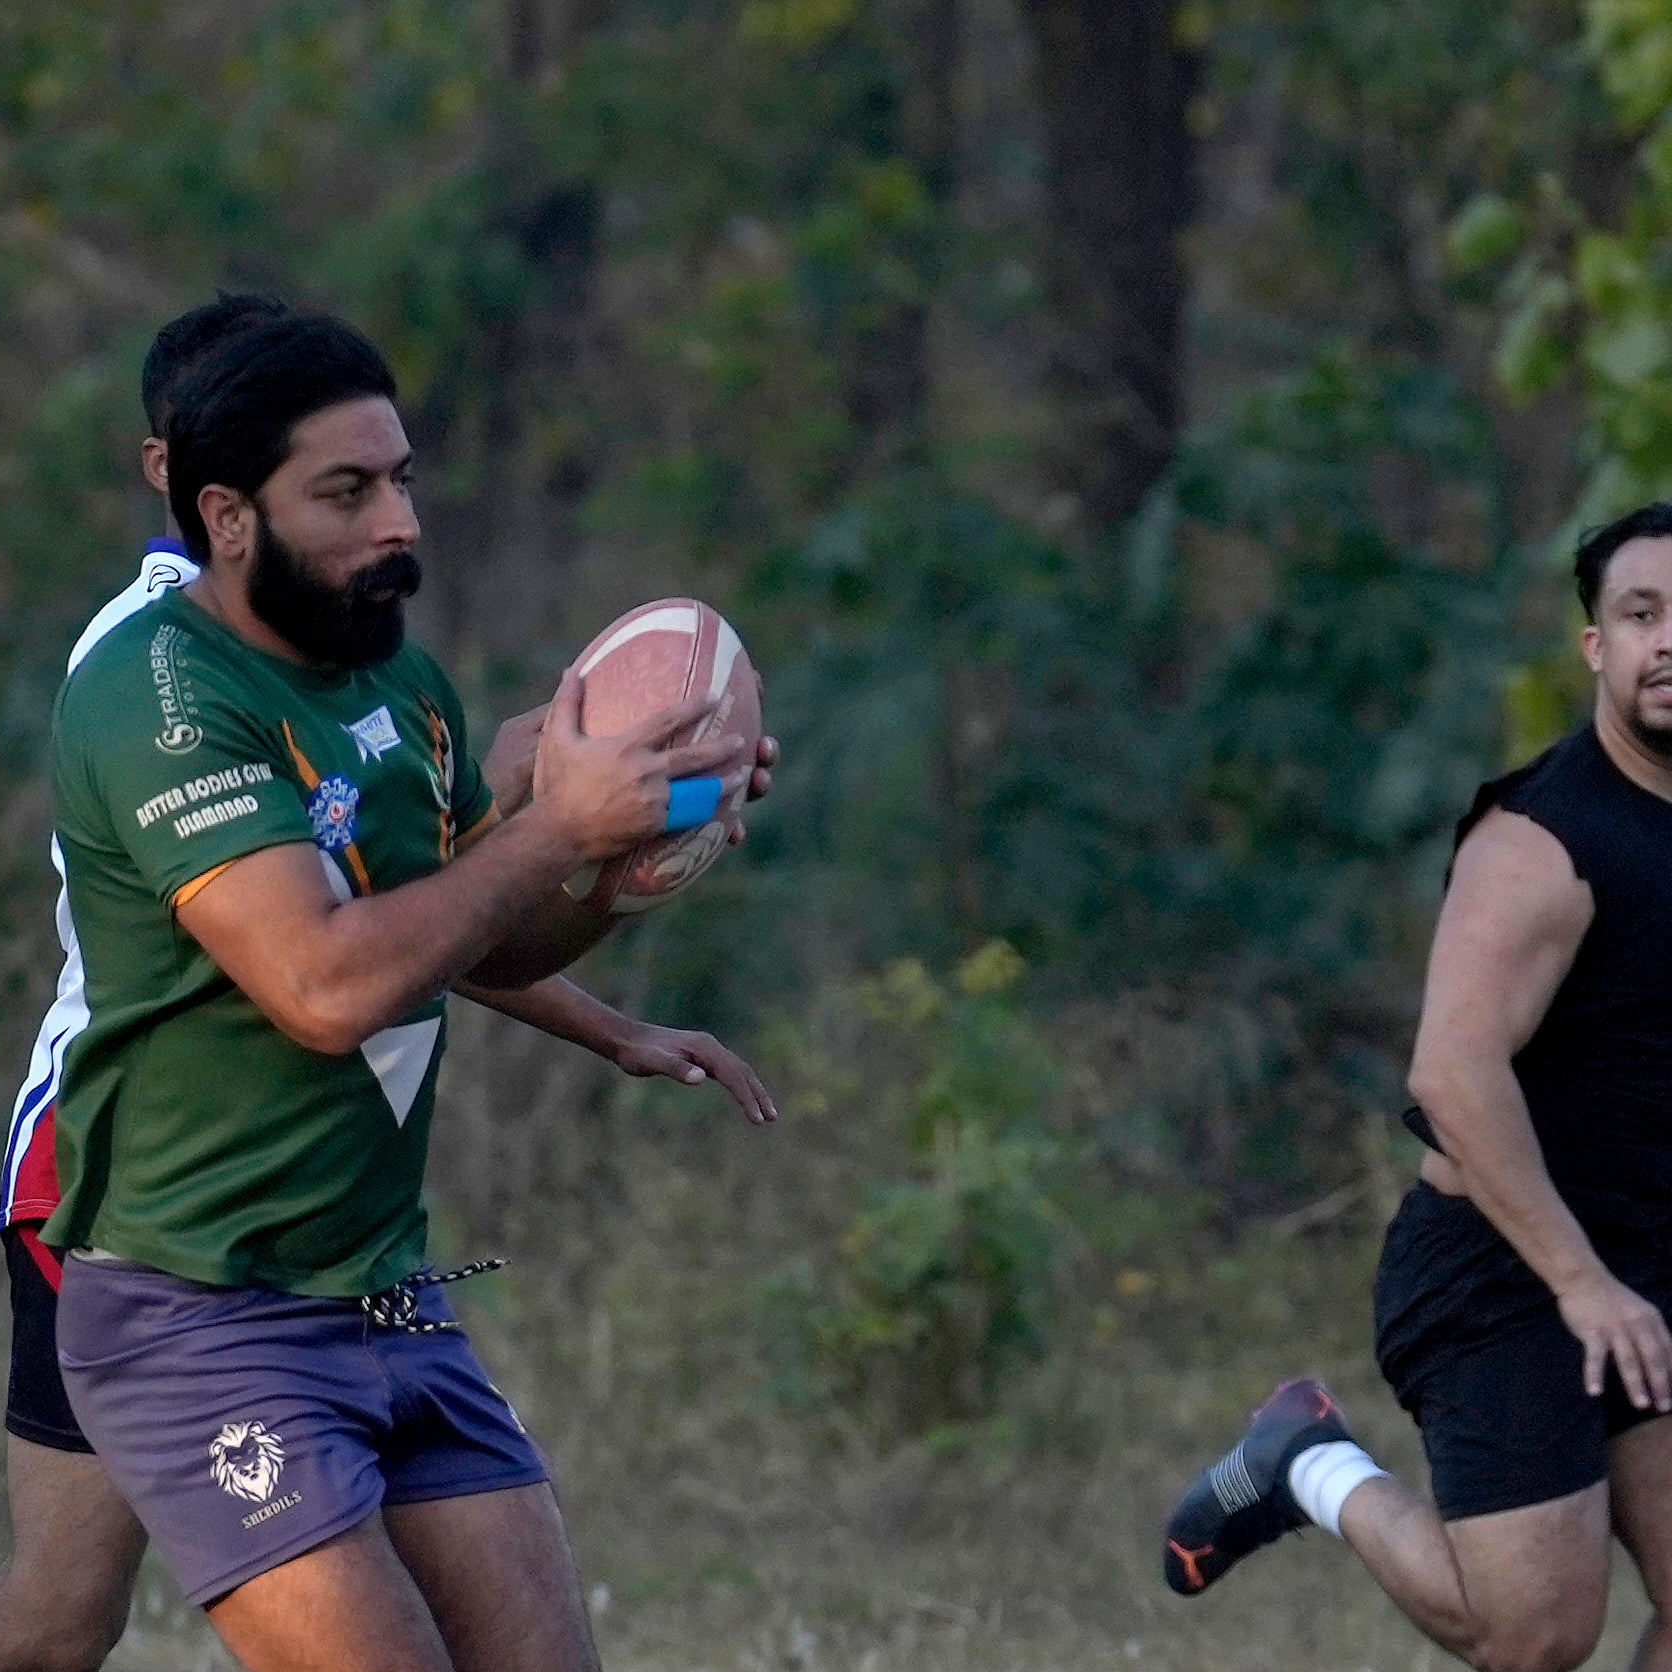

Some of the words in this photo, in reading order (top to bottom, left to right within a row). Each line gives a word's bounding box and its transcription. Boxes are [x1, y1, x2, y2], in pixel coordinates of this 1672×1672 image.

[136, 788, 187, 829] BETTER
[184, 767, 243, 802] BODIES
[242, 762, 274, 784] GYM
[173, 794, 259, 839] ISLAMABAD
[241, 1490, 303, 1529] SHERDILS
